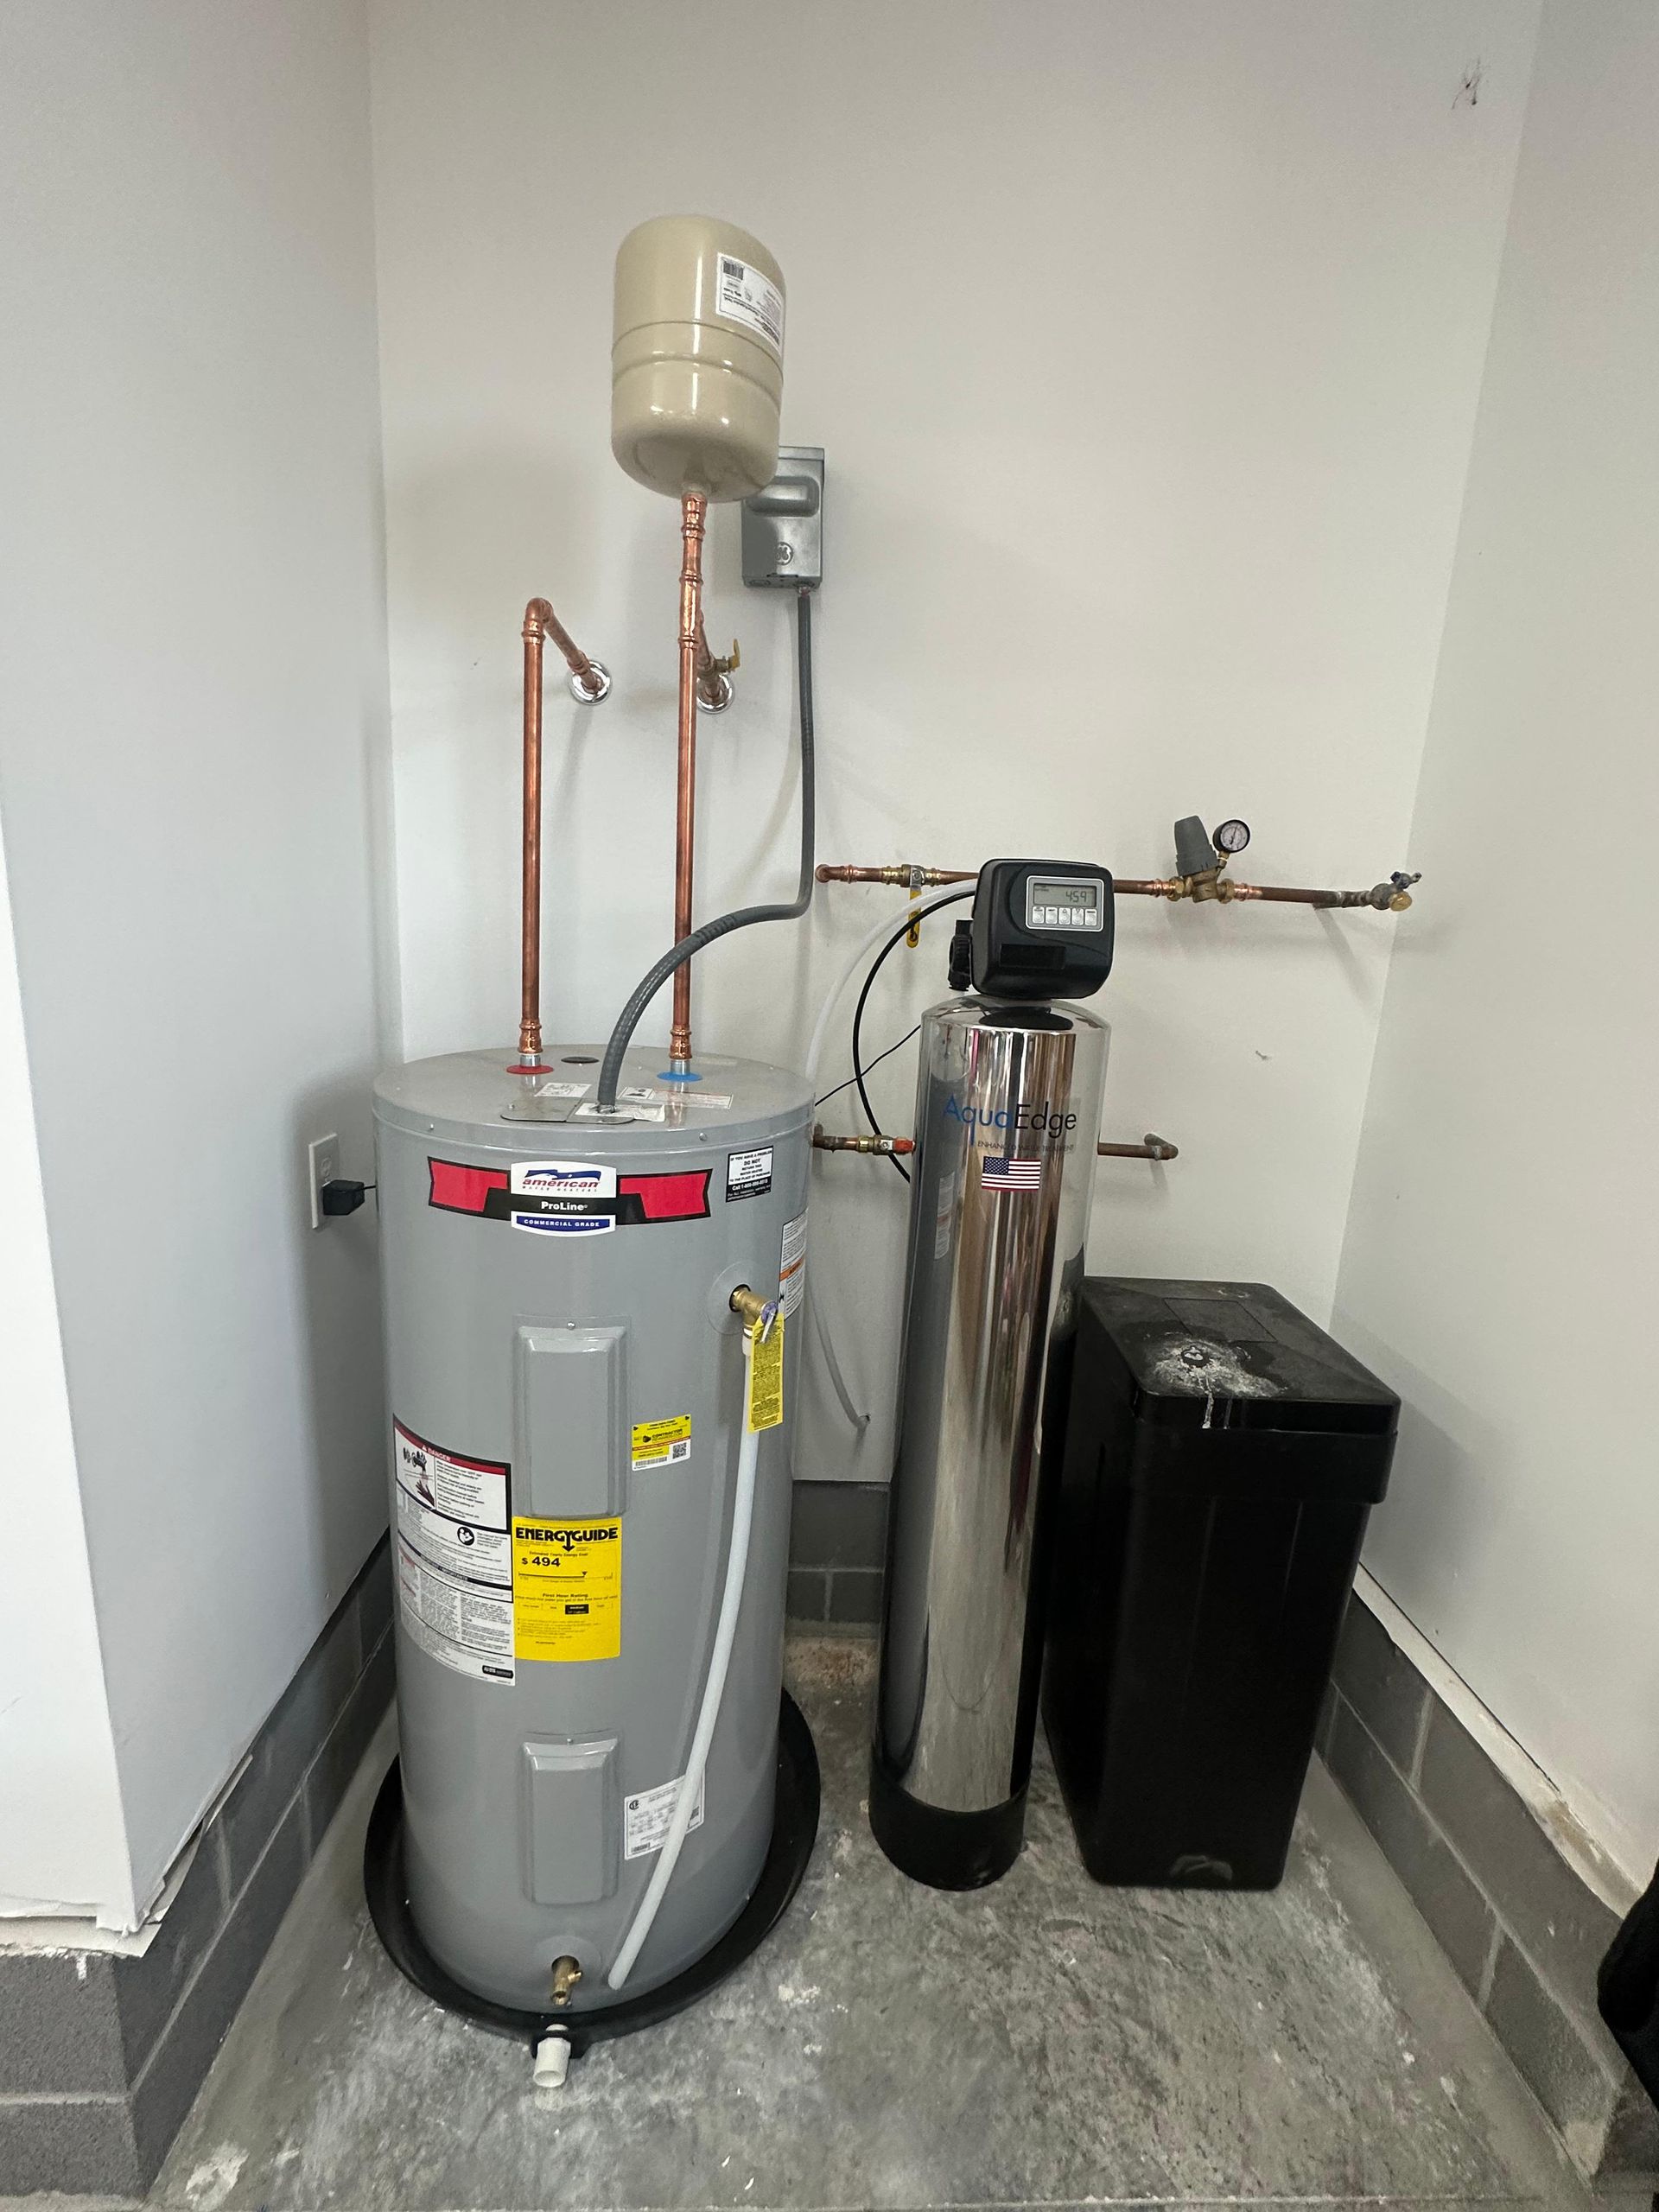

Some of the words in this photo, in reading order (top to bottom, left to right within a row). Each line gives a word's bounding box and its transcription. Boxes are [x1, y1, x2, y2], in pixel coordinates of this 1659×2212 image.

[522, 1179, 598, 1188] american
[516, 1527, 618, 1544] ENERGYGUIDE
[531, 1556, 561, 1567] 494
